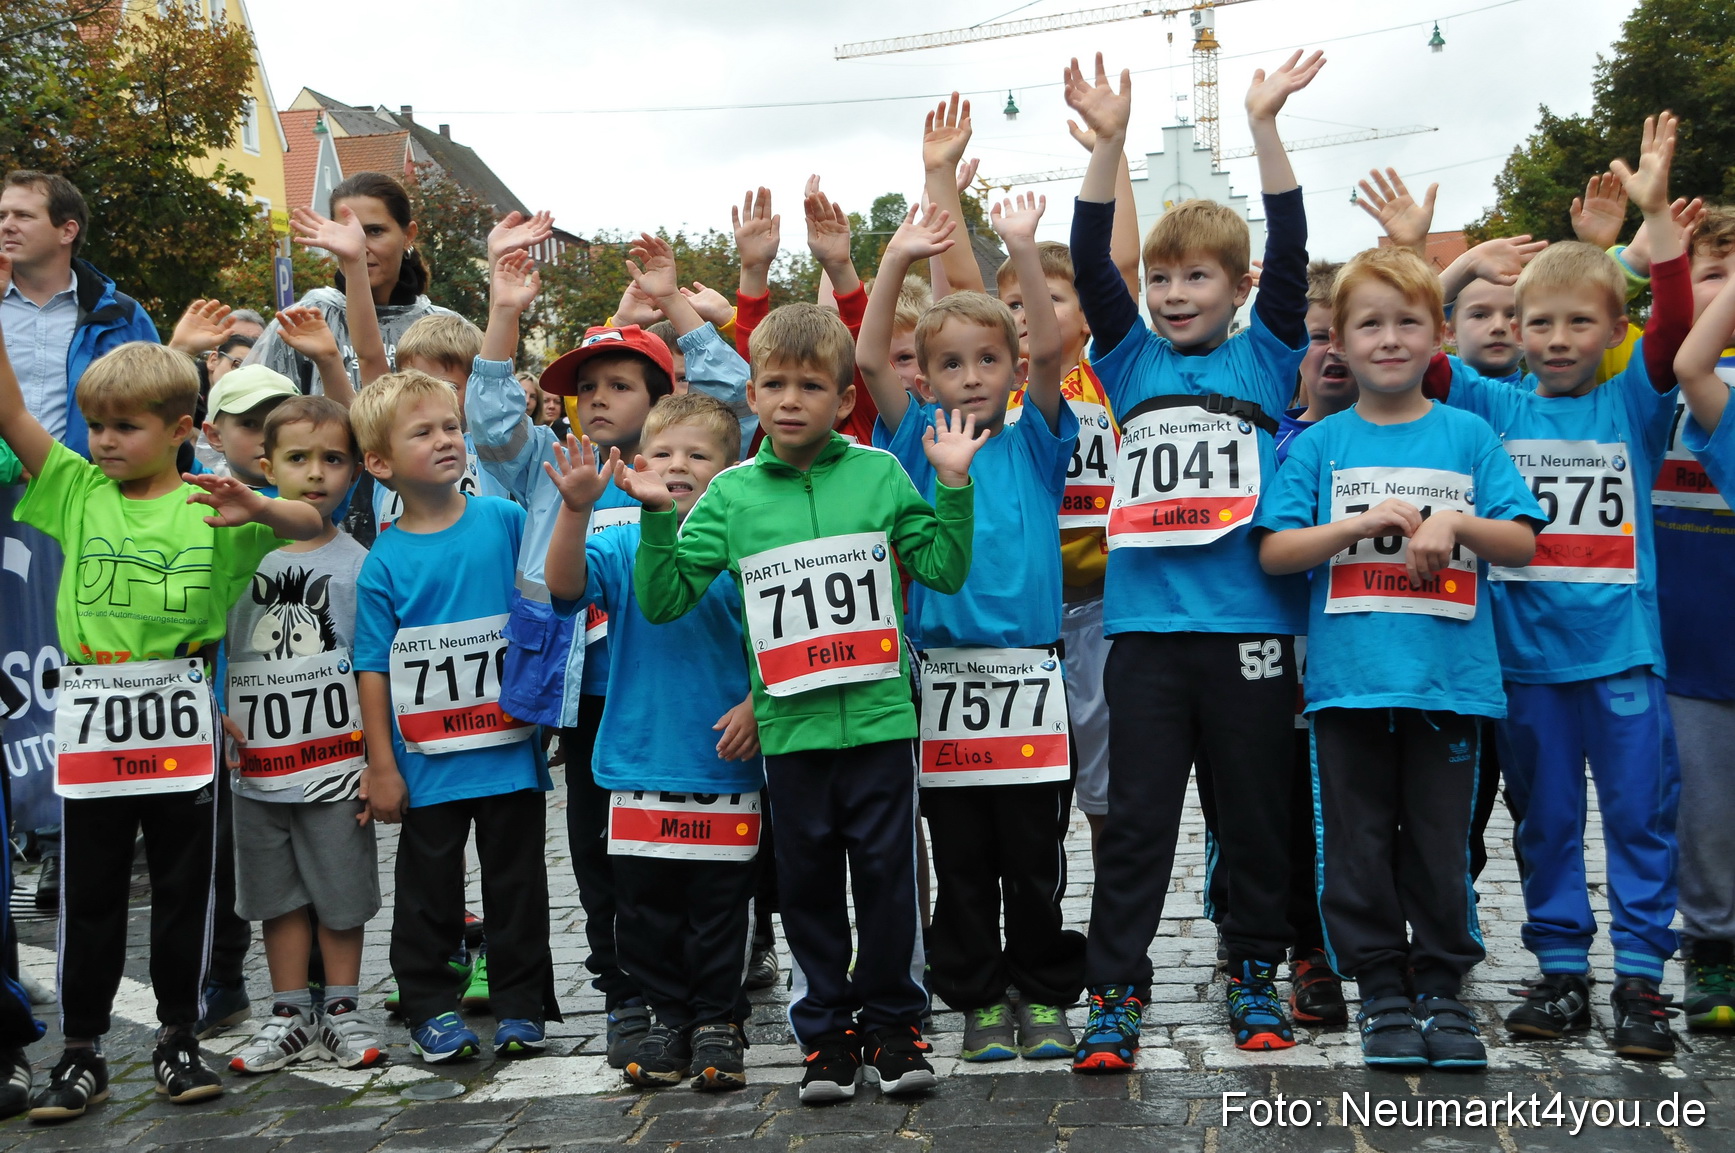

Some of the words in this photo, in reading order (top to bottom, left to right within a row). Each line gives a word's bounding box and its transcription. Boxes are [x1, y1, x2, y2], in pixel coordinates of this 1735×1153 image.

[278, 264, 290, 308] P
[1077, 414, 1094, 427] rkt
[1121, 426, 1156, 448] PARTL
[1159, 420, 1232, 435] Neumarkt
[1127, 439, 1240, 499] 7041
[1675, 467, 1713, 491] Rap
[1335, 482, 1380, 498] PARTL
[1385, 482, 1460, 501] Neumarkt
[1522, 476, 1624, 528] 575
[1152, 506, 1211, 526] Lukas
[744, 563, 792, 585] PARTL
[794, 549, 867, 571] Neumarkt
[759, 568, 880, 640] 7191
[392, 639, 436, 654] PARTL
[807, 641, 856, 667] Felix
[1238, 638, 1283, 680] 52
[231, 675, 265, 687] PARTL
[267, 666, 334, 686] Neumarkt
[923, 662, 965, 675] PARTL
[967, 661, 1035, 675] Neumarkt
[64, 678, 110, 691] PARTL
[113, 673, 183, 689] Neumarkt
[73, 689, 200, 745] 7006
[239, 682, 350, 741] 7070
[932, 677, 1050, 732] 7577
[443, 712, 498, 734] Kilian
[113, 755, 157, 776] Toni
[935, 742, 993, 767] Elias
[661, 817, 711, 840] Matti
